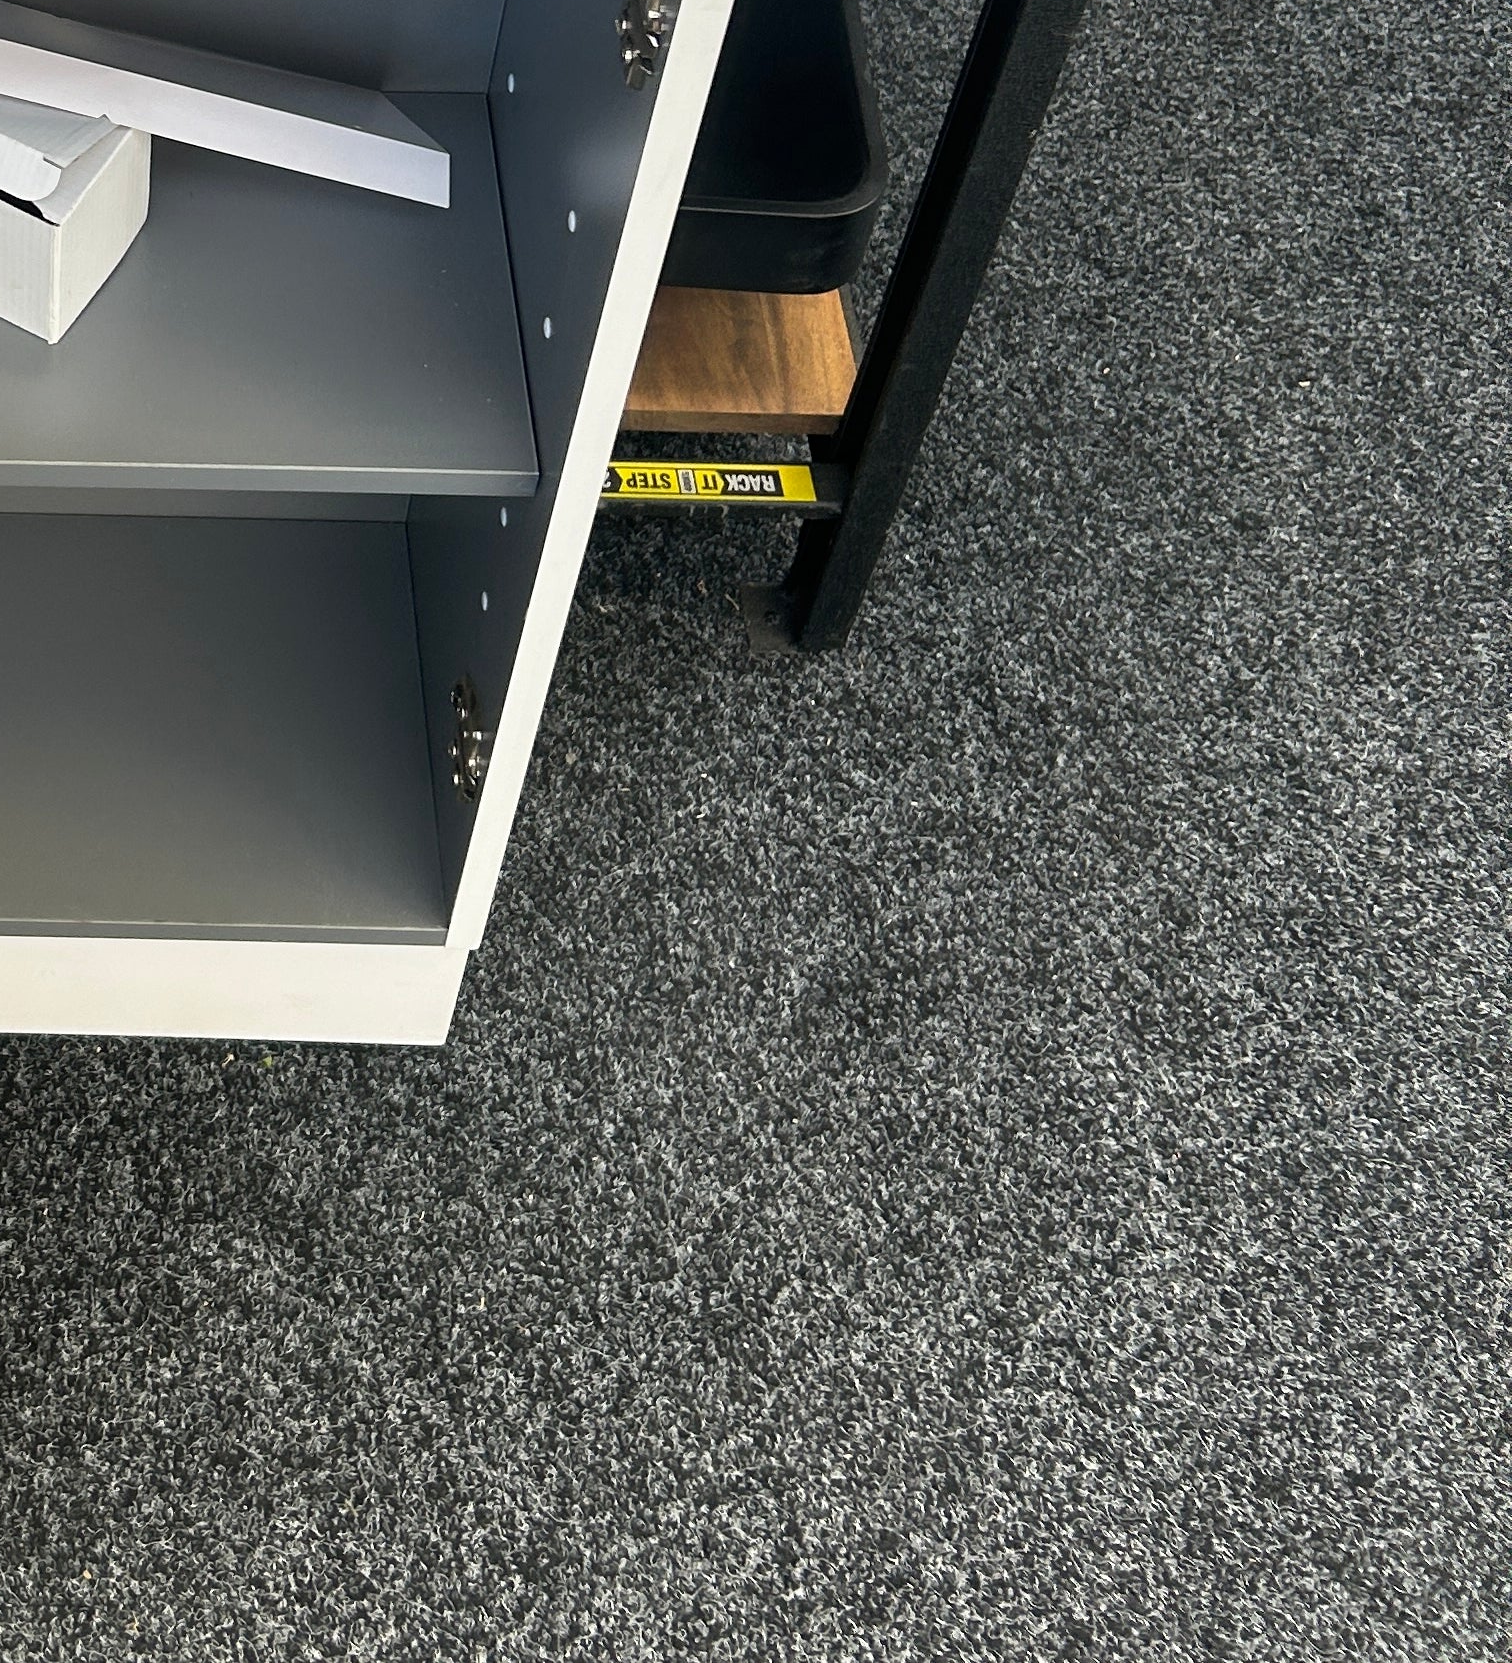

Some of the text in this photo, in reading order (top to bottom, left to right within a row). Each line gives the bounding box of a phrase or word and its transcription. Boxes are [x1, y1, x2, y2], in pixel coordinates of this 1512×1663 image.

[626, 472, 672, 489] STEP
[702, 474, 718, 490] IT
[726, 474, 776, 492] RACK
